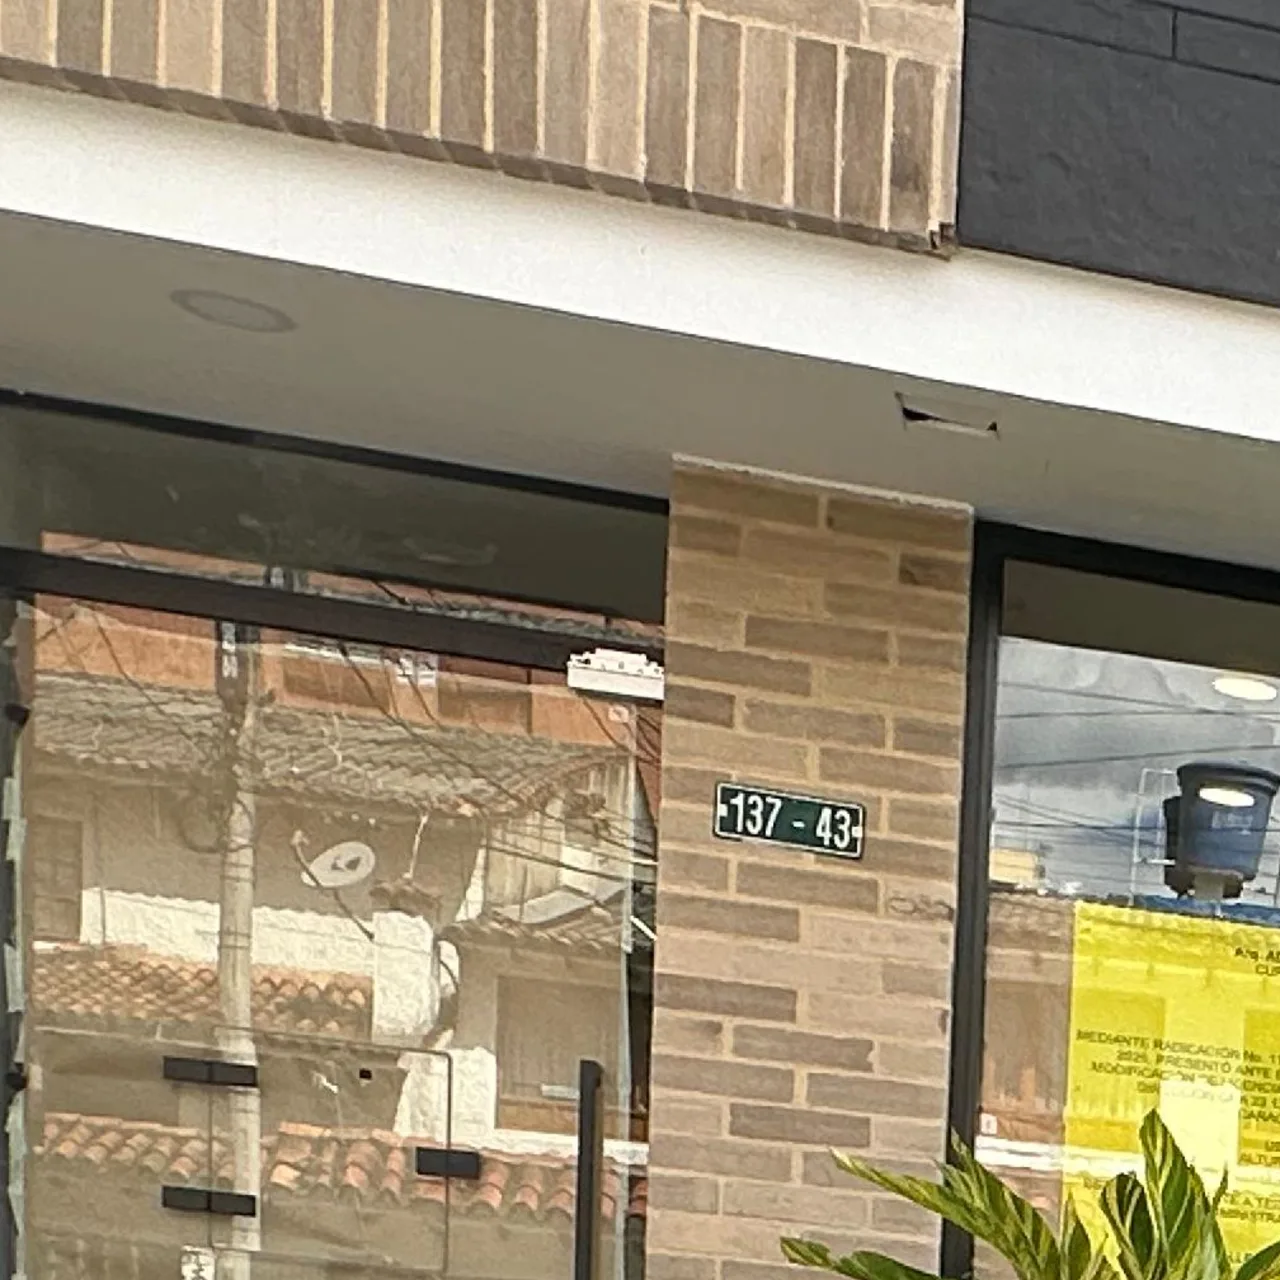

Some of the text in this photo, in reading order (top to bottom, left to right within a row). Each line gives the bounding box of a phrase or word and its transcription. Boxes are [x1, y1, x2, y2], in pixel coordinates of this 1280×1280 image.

[731, 792, 851, 849] 137 - 43
